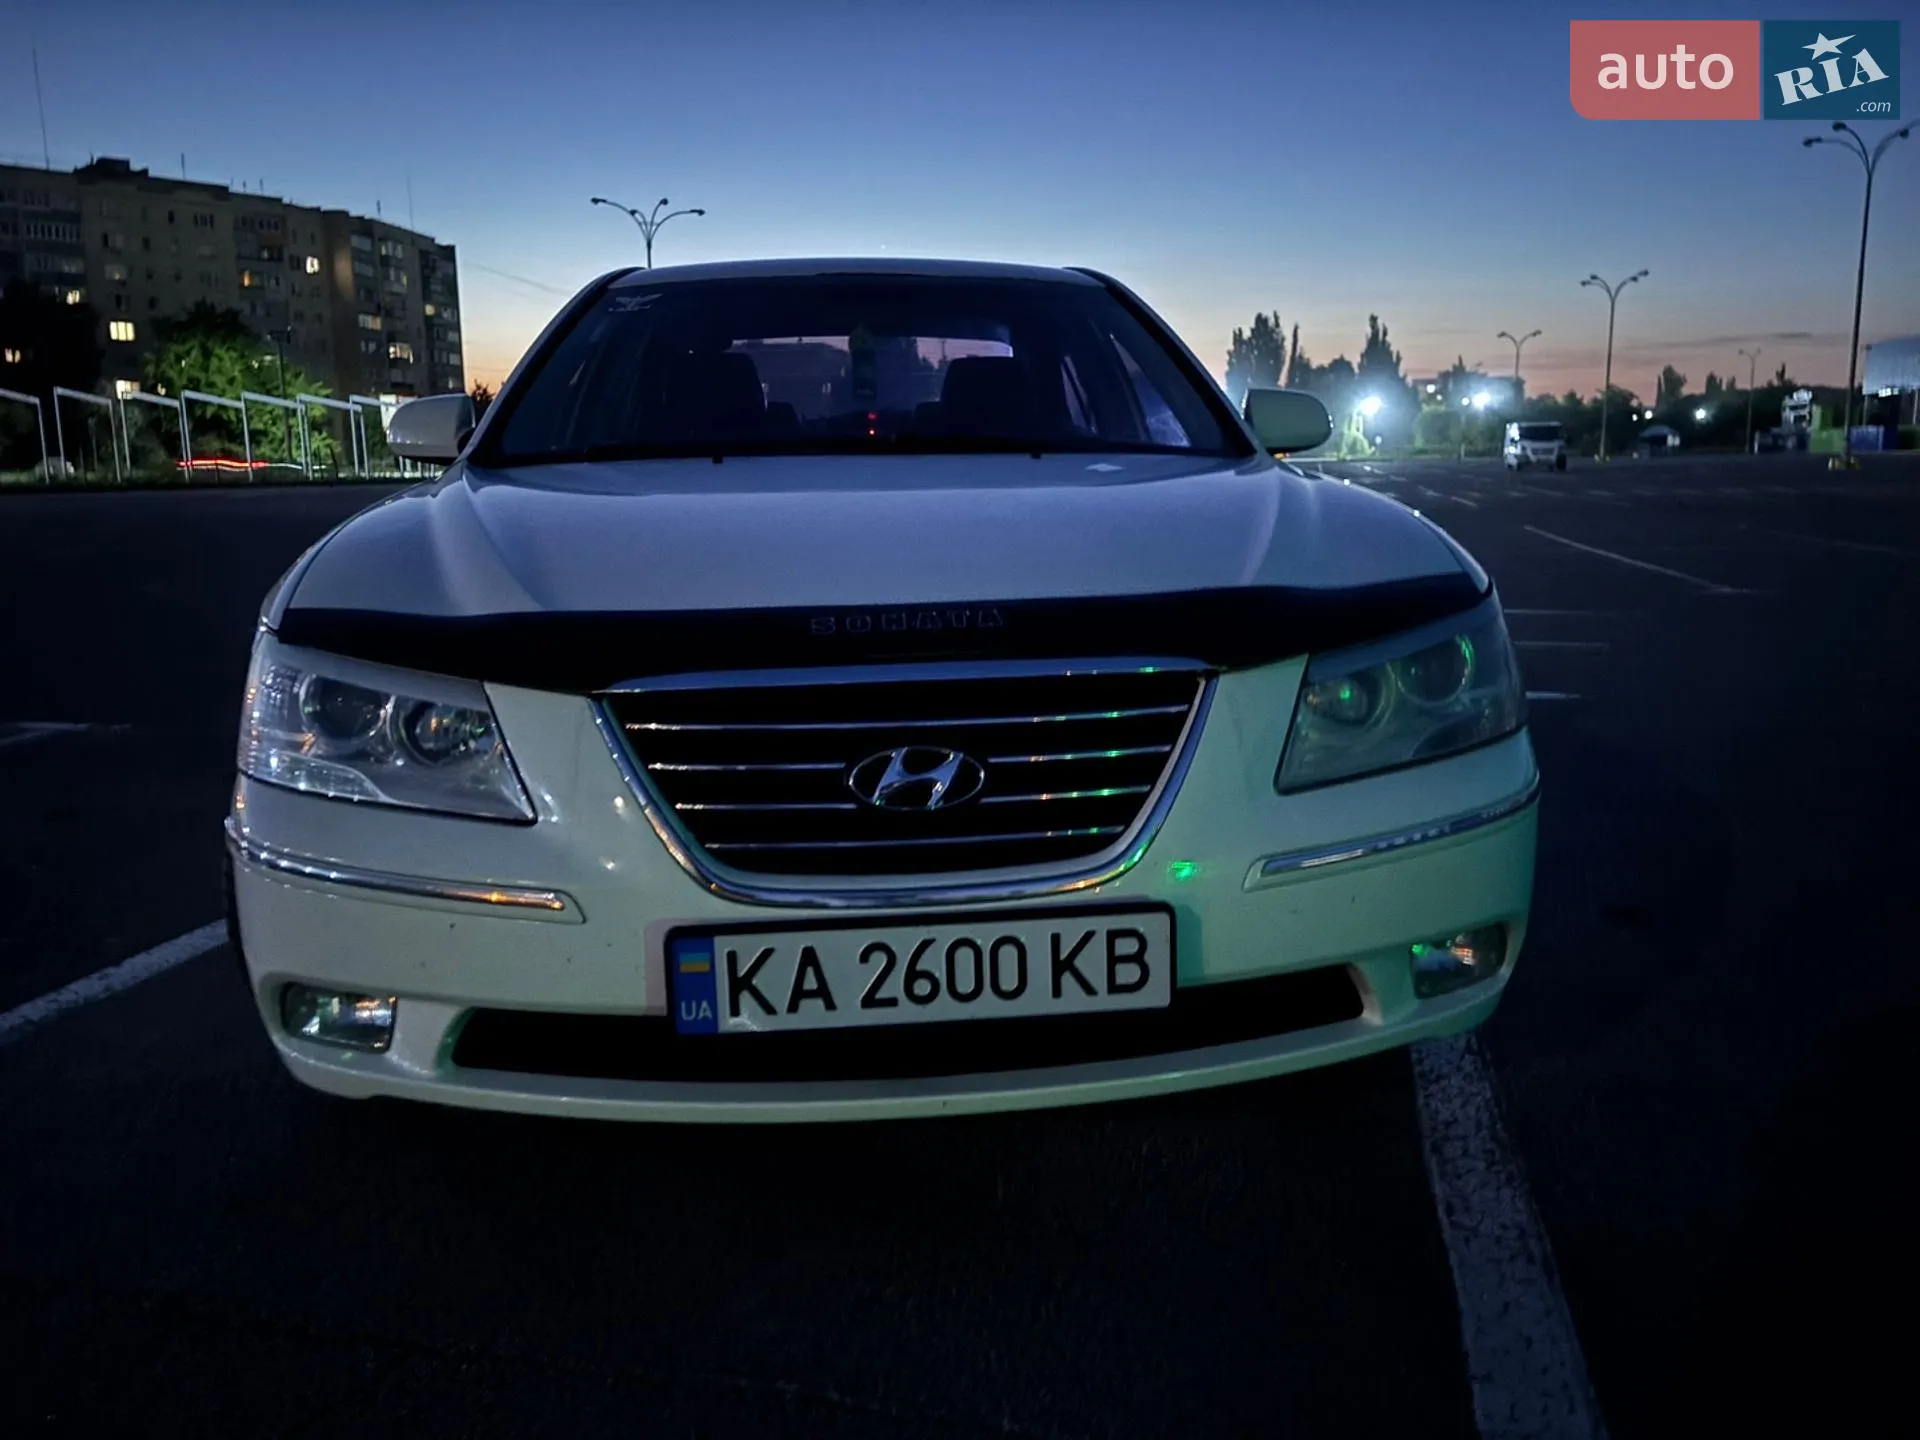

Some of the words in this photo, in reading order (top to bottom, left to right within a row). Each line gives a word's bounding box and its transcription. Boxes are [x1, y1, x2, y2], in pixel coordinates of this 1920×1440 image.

[726, 945, 838, 1017] KA
[858, 935, 1028, 1009] 2600
[1050, 927, 1151, 999] KB
[681, 1000, 713, 1020] UA
